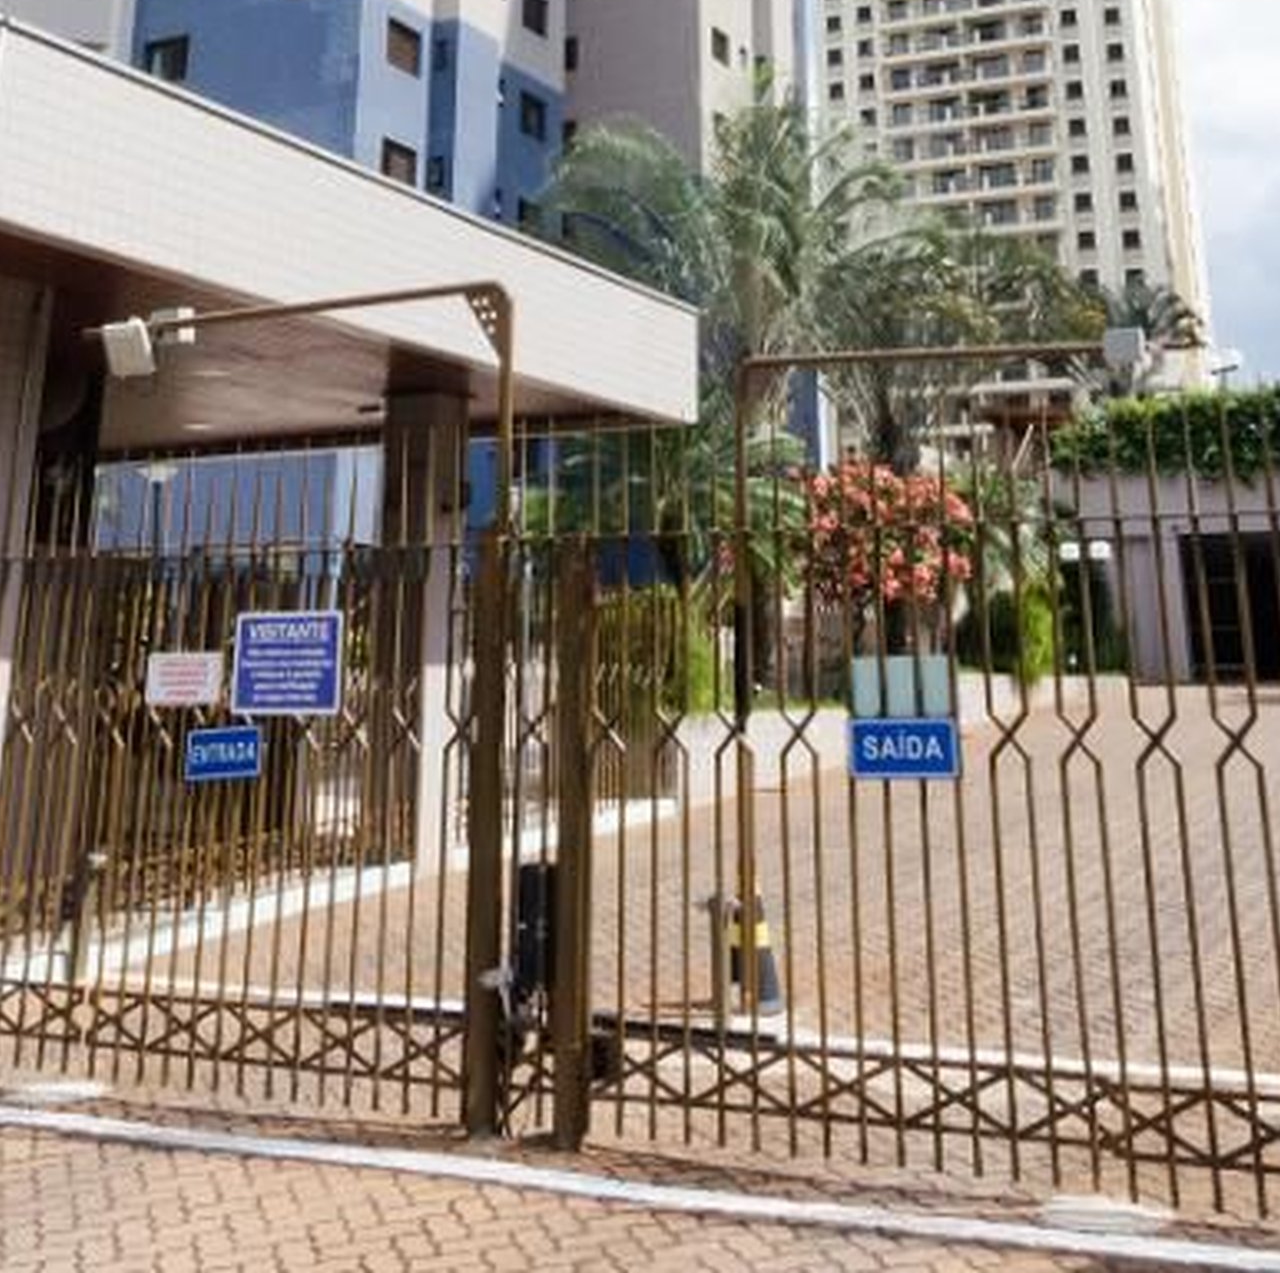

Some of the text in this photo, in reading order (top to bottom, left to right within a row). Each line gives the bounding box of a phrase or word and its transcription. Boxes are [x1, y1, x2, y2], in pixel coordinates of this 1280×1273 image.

[248, 622, 330, 642] VISITANTE
[191, 740, 256, 765] ENTRADA
[862, 729, 944, 761] SAÍDA
